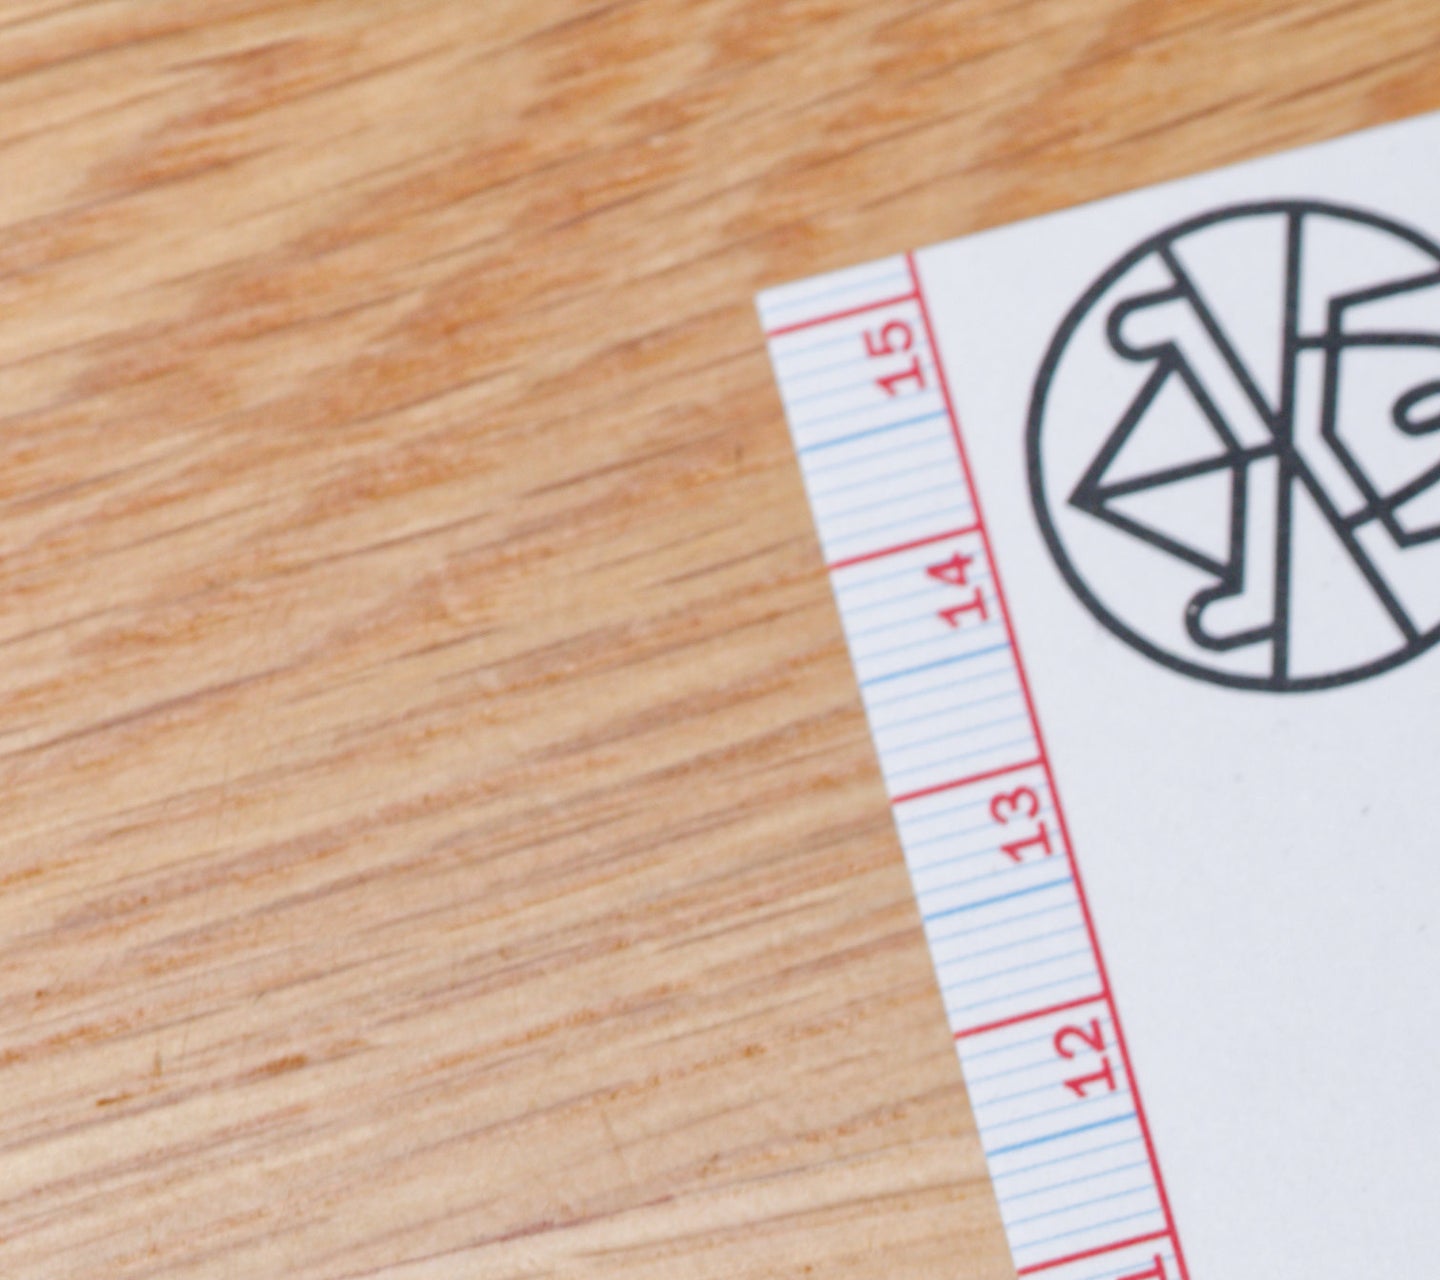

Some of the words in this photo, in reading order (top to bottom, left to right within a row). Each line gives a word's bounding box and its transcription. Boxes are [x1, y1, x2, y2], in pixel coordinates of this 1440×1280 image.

[864, 319, 928, 399] 15
[924, 551, 993, 628] 14
[989, 783, 1052, 863] 13
[1054, 1017, 1117, 1098] 12
